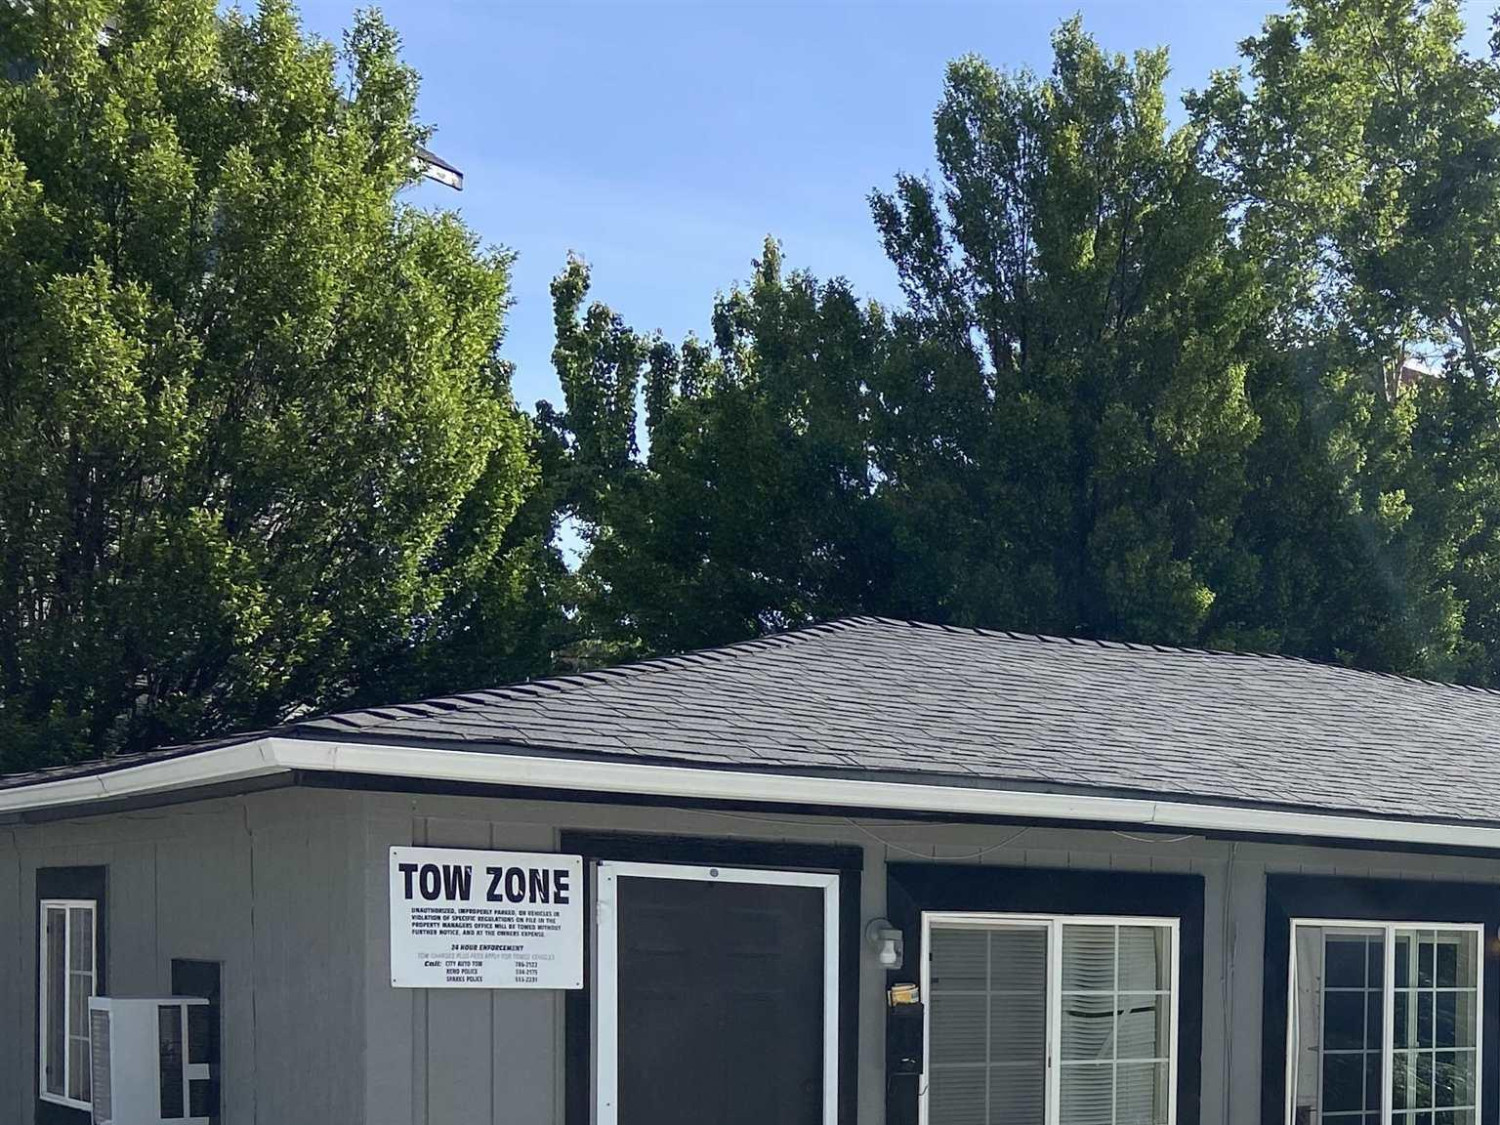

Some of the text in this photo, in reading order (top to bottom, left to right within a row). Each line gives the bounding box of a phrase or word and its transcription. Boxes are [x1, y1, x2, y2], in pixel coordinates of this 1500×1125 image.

[398, 863, 570, 905] TOW ZONE
[479, 944, 524, 952] ENFORCEMENT
